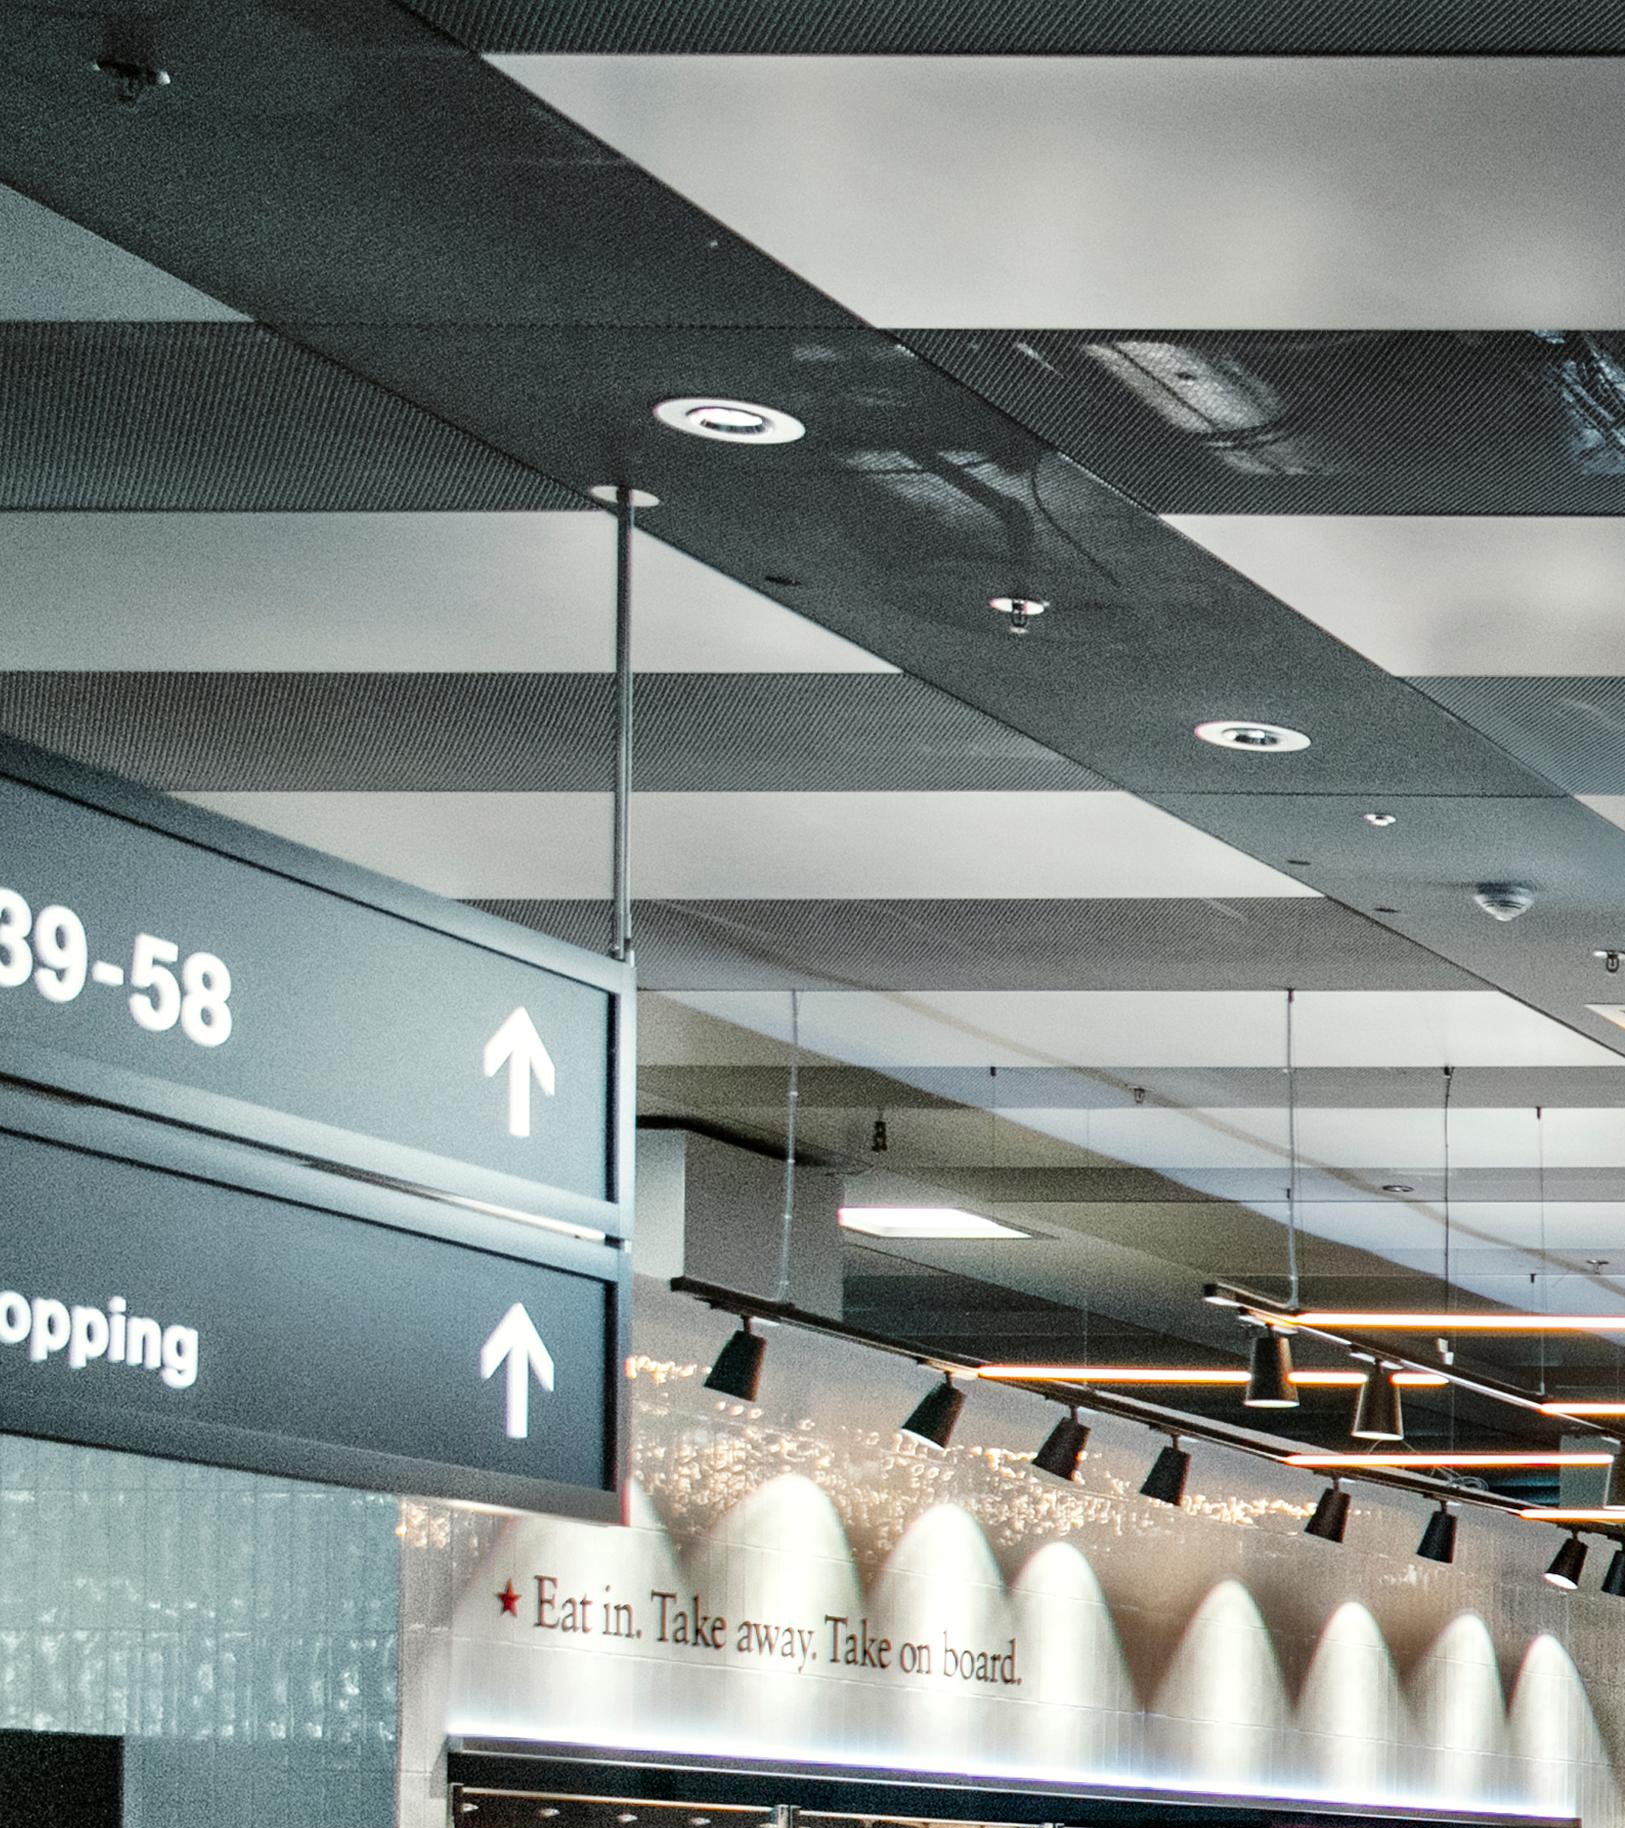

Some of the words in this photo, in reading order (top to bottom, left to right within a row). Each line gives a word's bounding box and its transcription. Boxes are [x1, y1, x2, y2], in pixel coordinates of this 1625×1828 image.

[0, 886, 233, 1048] 39-58
[533, 1574, 592, 1633] Eat
[601, 1585, 643, 1640] in.
[650, 1589, 726, 1651] Take
[737, 1617, 818, 1674] away.
[825, 1613, 892, 1670] Take
[899, 1637, 932, 1675] on
[943, 1630, 1023, 1687] board.
